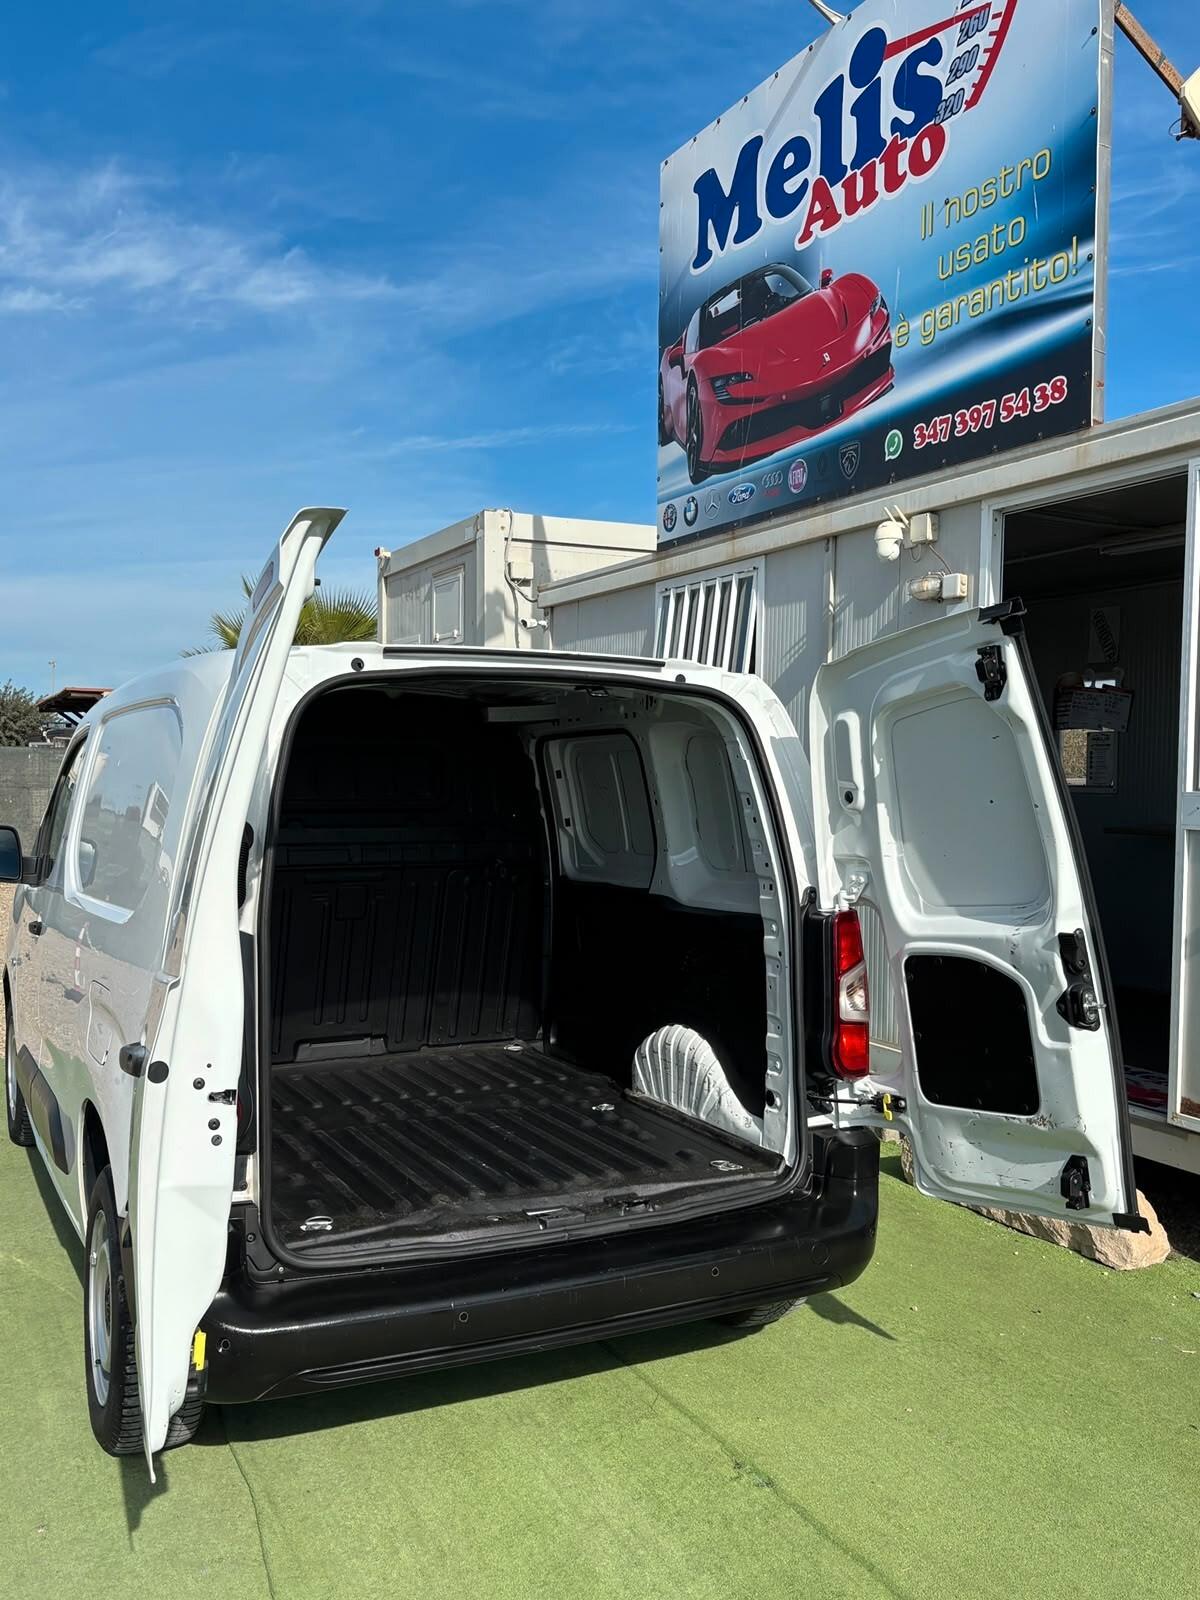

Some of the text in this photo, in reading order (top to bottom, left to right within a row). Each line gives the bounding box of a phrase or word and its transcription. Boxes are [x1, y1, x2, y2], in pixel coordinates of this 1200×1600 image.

[957, 7, 991, 47] 260
[945, 44, 980, 87] 290
[933, 88, 965, 126] 320
[691, 26, 944, 271] Melis
[796, 122, 948, 246] Auto
[920, 148, 1052, 240] Il nostro
[937, 216, 1026, 280] usato
[894, 235, 1079, 348] è garantito!
[913, 375, 1067, 449] 347 397 54 38
